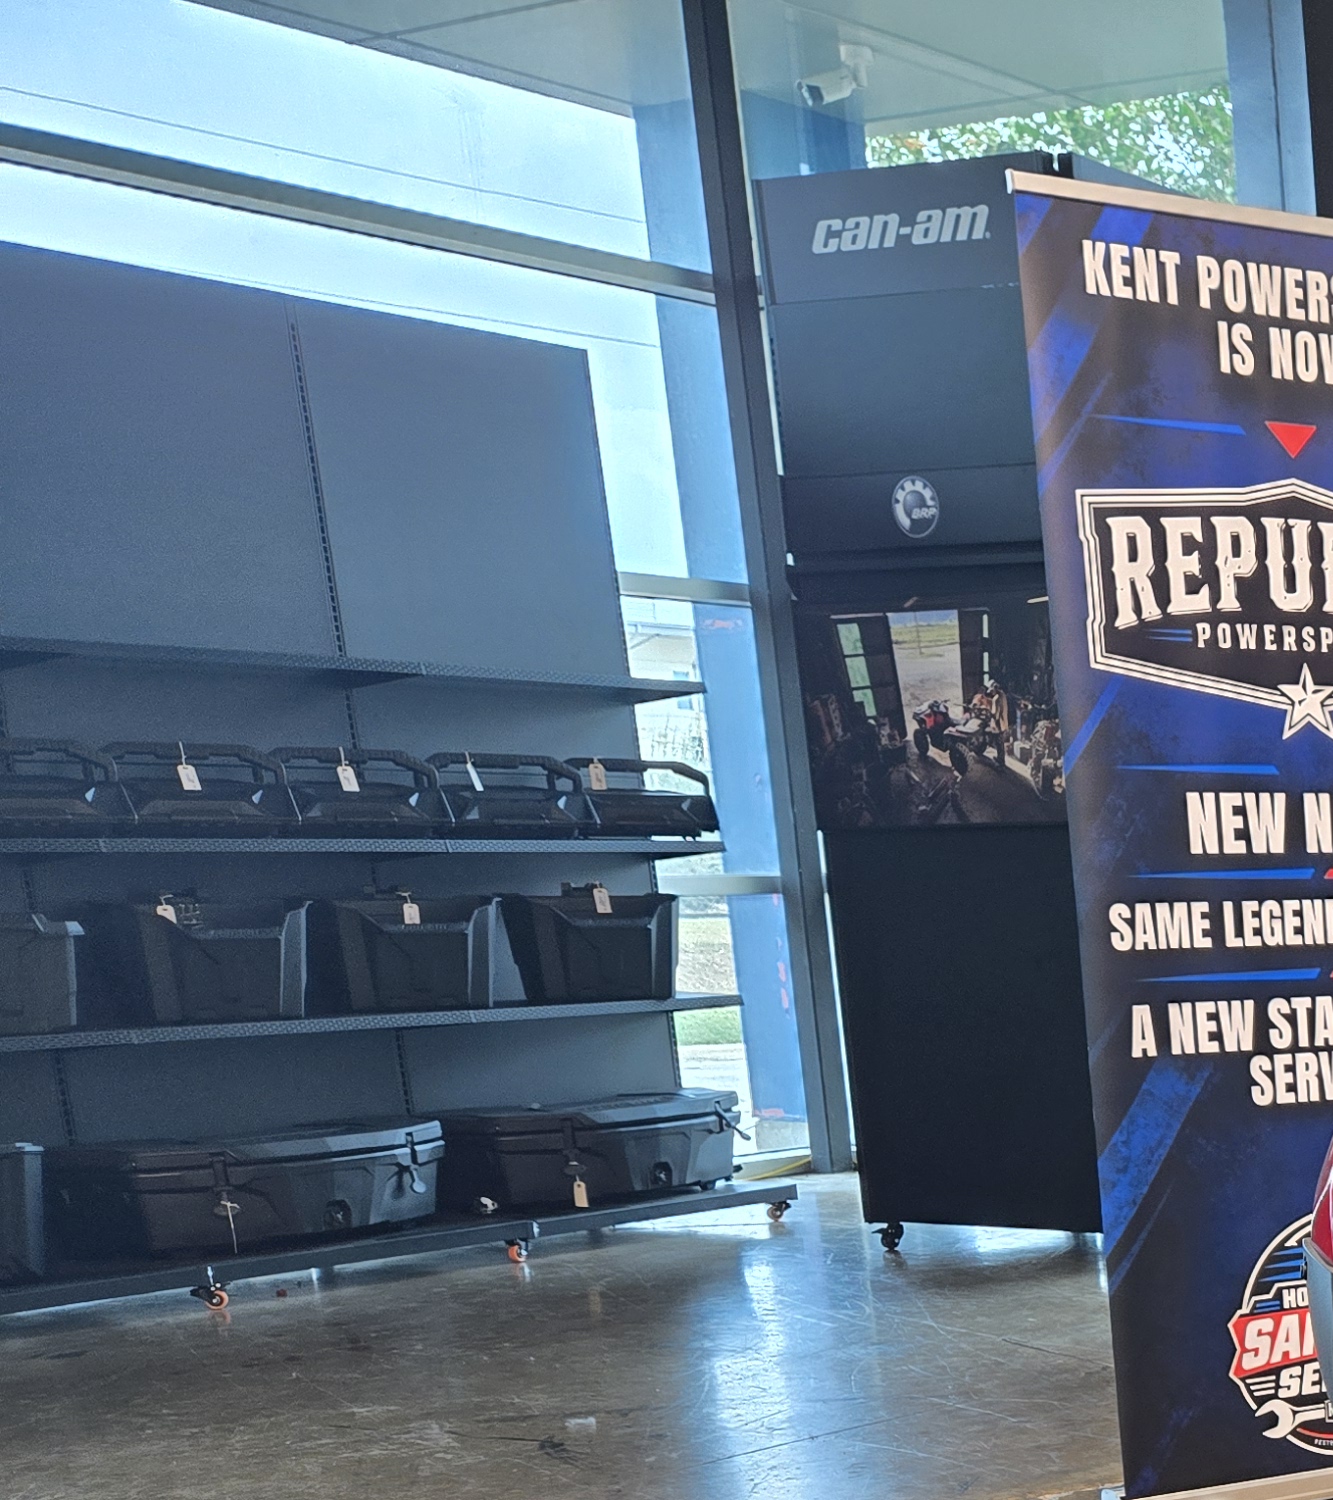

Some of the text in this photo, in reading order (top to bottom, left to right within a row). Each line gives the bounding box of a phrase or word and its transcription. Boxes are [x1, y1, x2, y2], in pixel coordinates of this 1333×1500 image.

[812, 204, 990, 254] can-am
[1082, 239, 1180, 306] KENT
[1217, 320, 1255, 377] IS
[911, 507, 937, 519] BRP
[1186, 792, 1287, 854] NEW
[1108, 900, 1213, 950] SAME
[1131, 1003, 1158, 1058] A
[1168, 999, 1254, 1055] NEW
